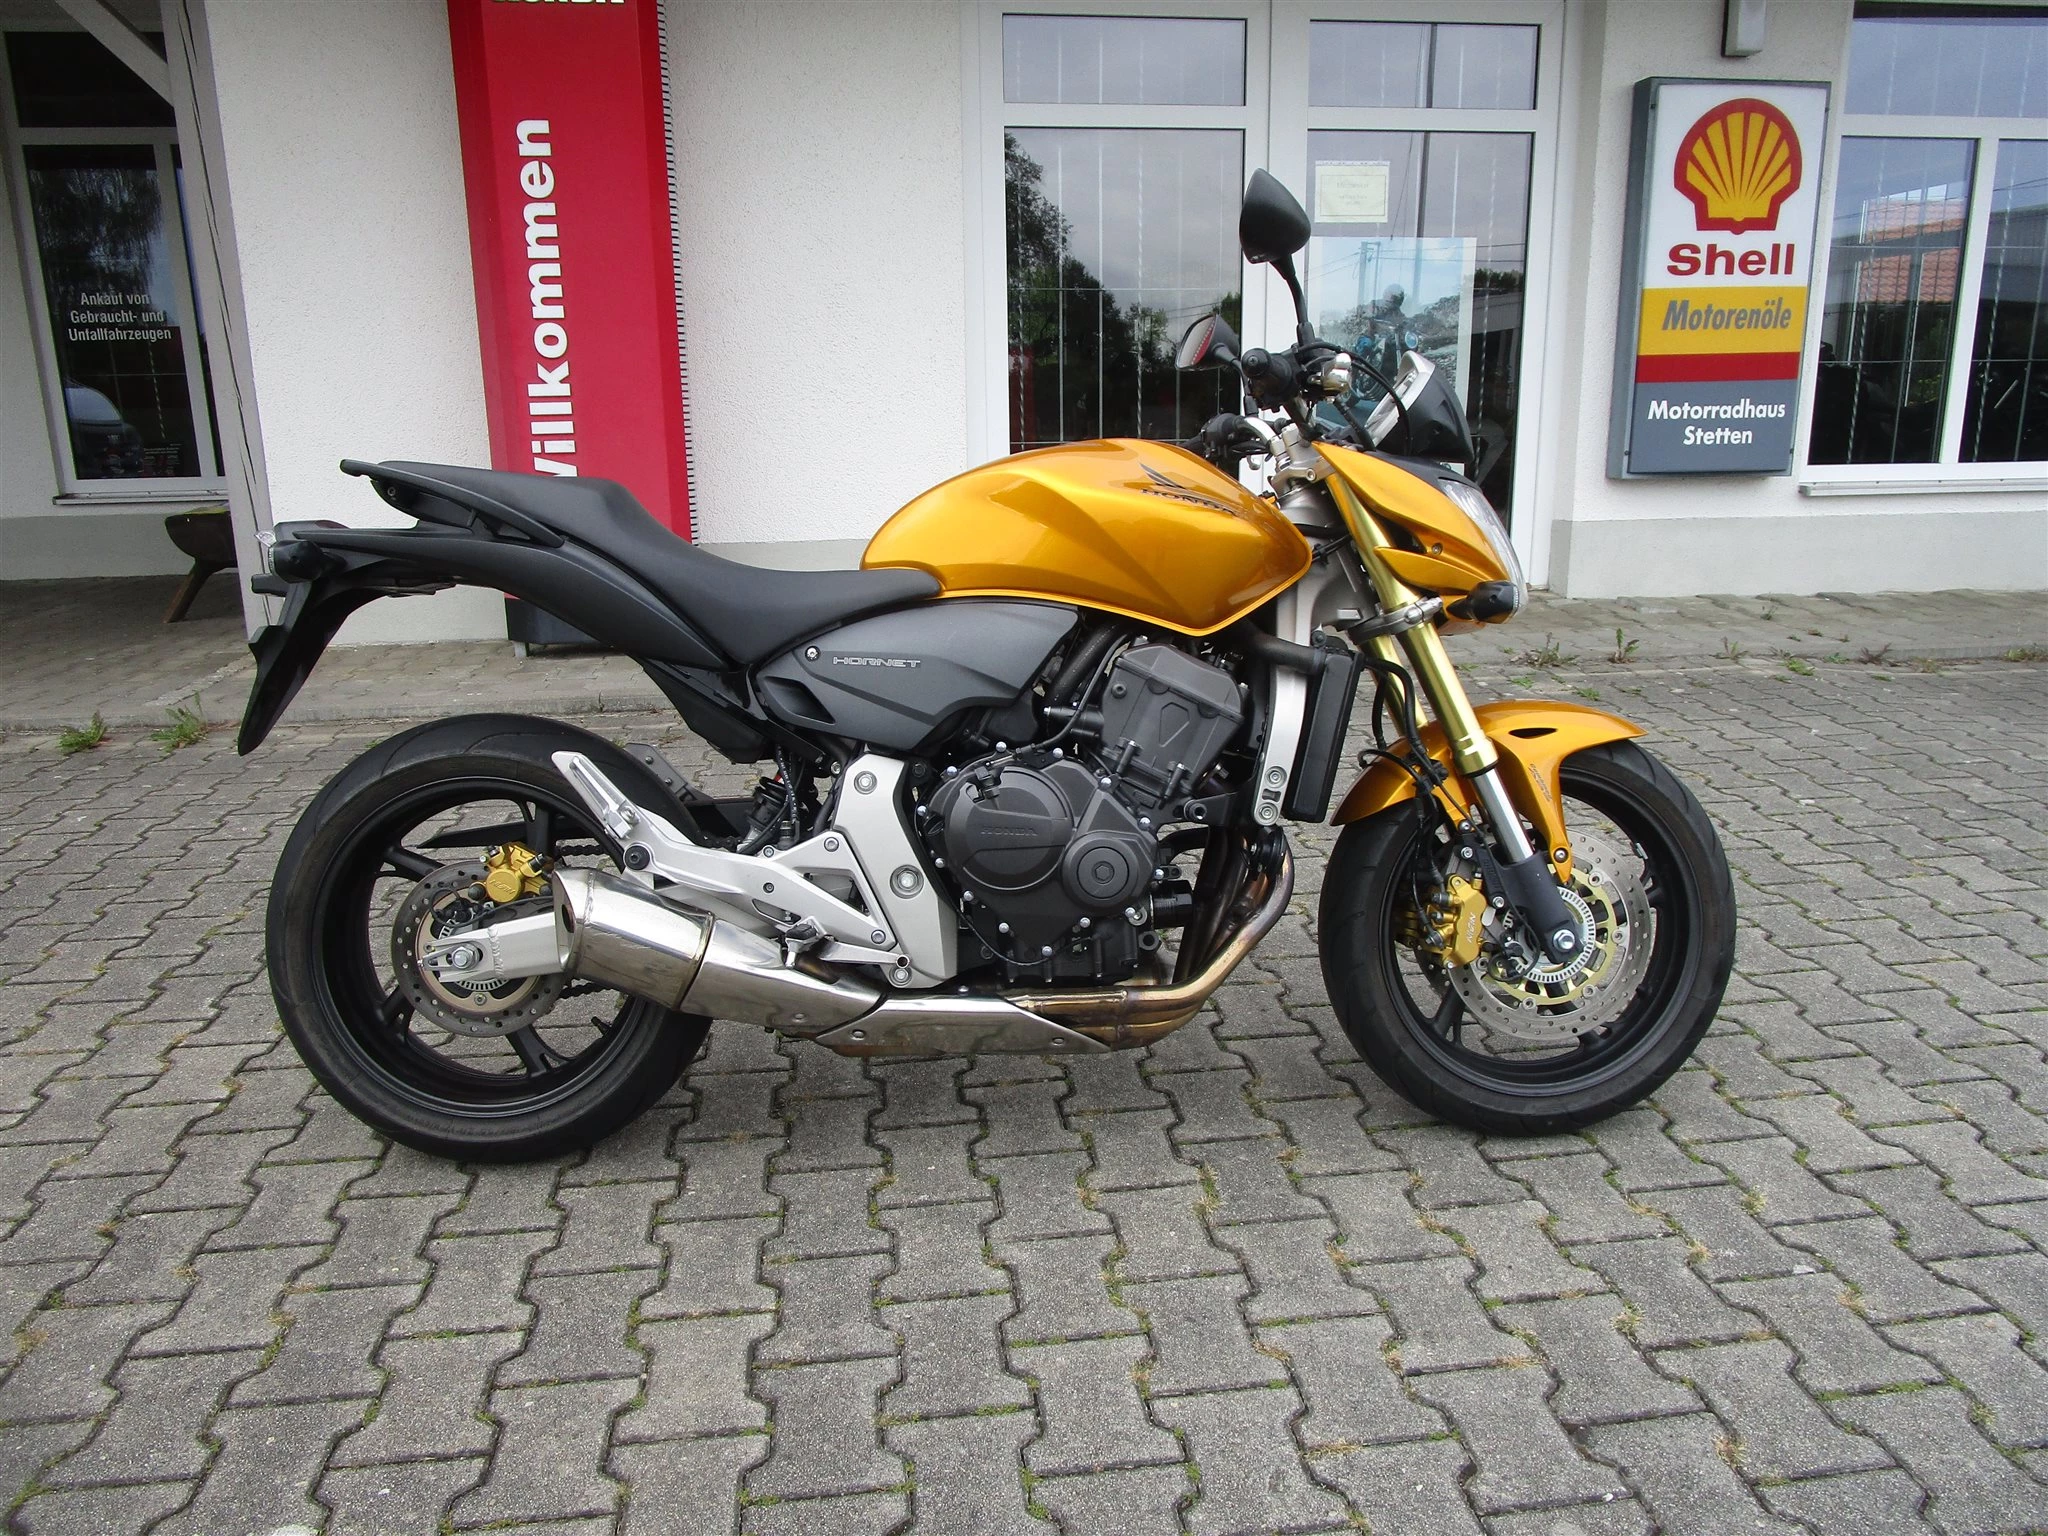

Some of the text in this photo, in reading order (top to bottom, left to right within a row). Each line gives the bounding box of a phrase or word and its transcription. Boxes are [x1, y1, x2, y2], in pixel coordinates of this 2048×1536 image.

[1666, 243, 1795, 276] Shell
[80, 292, 151, 306] Ankauf von
[70, 309, 165, 323] Gebraucht- und
[1662, 297, 1792, 331] Motorenöle
[68, 327, 172, 342] Unfallfahrzeugen
[1648, 398, 1786, 420] Motorradhaus
[1683, 425, 1753, 445] Stetten
[833, 656, 921, 668] HORNET
